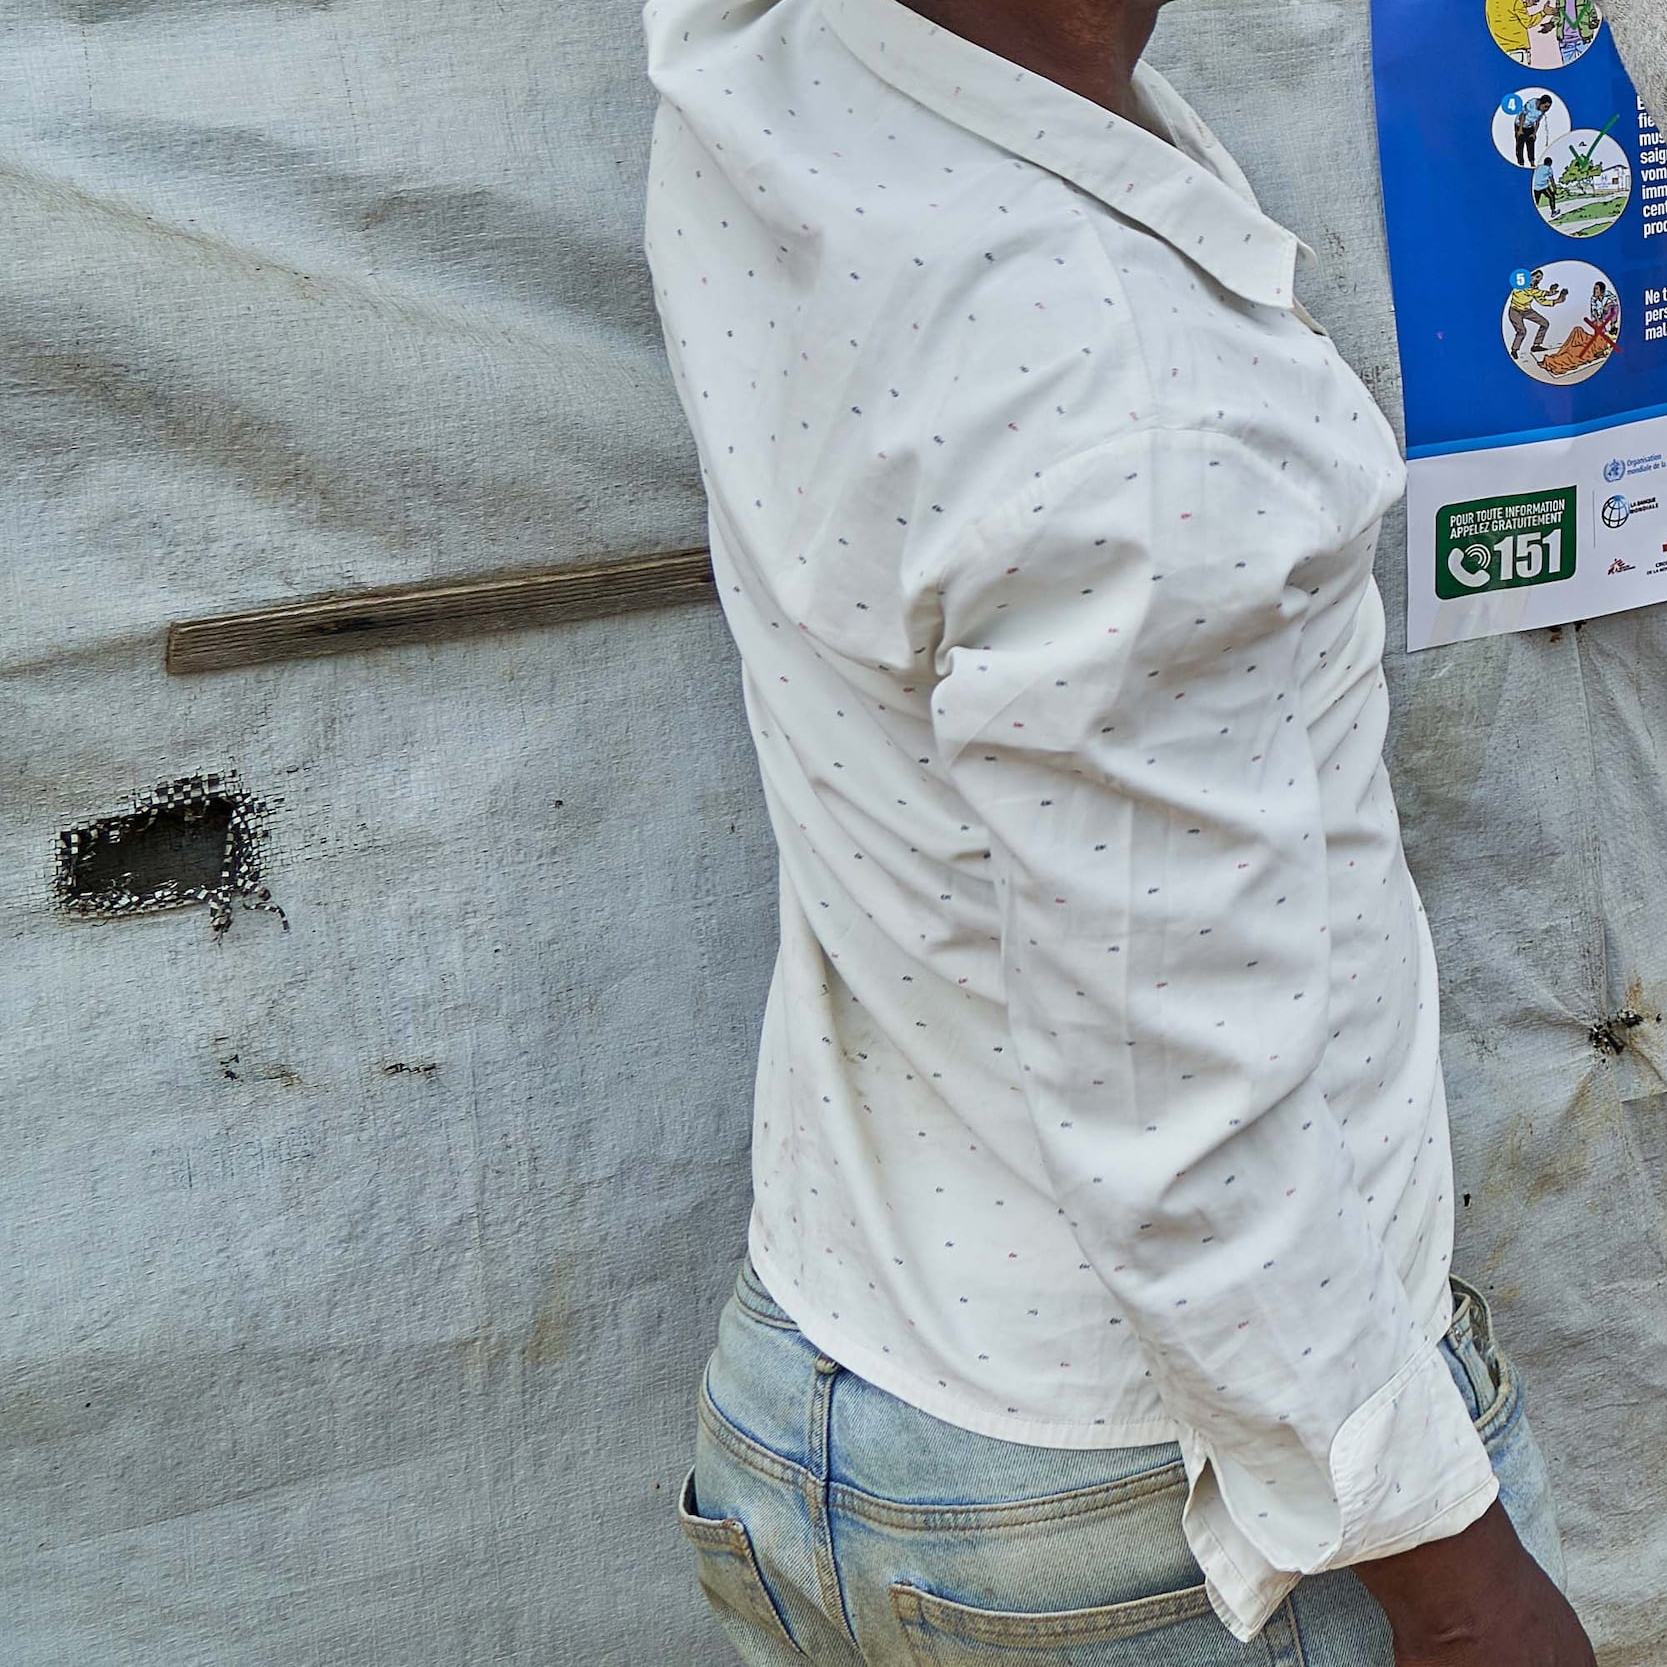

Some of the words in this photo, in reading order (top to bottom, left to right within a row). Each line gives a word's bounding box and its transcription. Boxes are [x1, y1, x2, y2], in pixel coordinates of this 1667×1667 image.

[1506, 98, 1517, 111] 4
[1516, 273, 1525, 286] 5
[1645, 289, 1660, 305] Ne
[1450, 512, 1474, 527] POUR
[1475, 507, 1503, 522] TOUTE
[1505, 499, 1565, 518] INFORMATION
[1450, 522, 1489, 539] APPELEZ
[1491, 511, 1563, 531] GRATUITEMENT
[1493, 528, 1562, 581] 151
